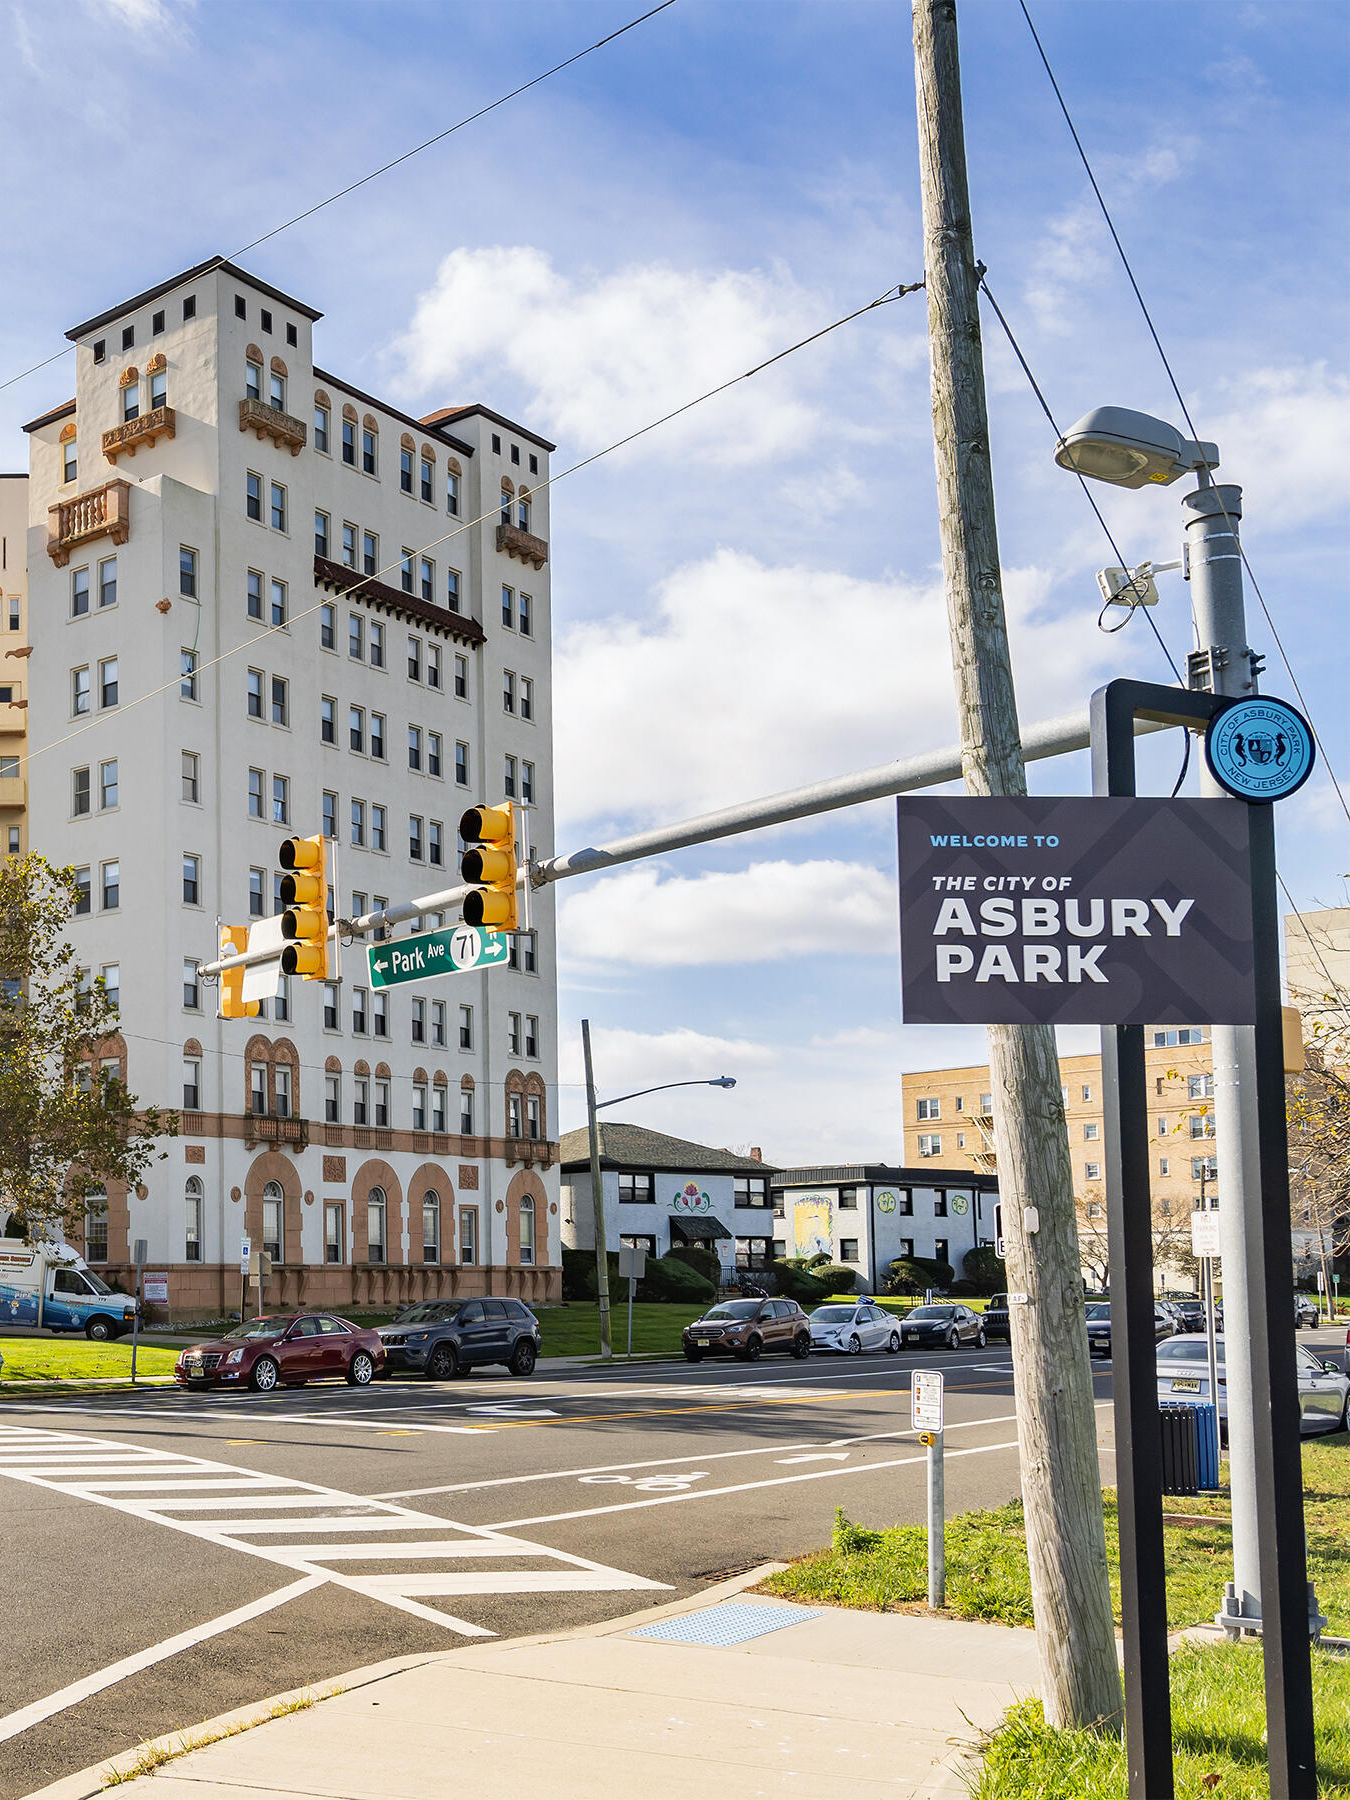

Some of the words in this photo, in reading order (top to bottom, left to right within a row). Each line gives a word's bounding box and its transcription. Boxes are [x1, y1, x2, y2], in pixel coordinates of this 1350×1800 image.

[1220, 731, 1230, 756] CITY
[1227, 716, 1240, 730] OF
[1243, 709, 1288, 725] ASBURY
[1286, 726, 1301, 755] PARK
[1228, 767, 1250, 786] NEW
[1253, 767, 1294, 789] JERSEY
[930, 835, 1028, 847] WELCOME
[1034, 835, 1060, 848] TO
[932, 876, 977, 891] THE
[983, 876, 1036, 891] CITY
[1041, 876, 1072, 891] OF
[932, 897, 1196, 938] ASBURY
[391, 946, 426, 974] Park
[427, 943, 445, 959] Ave
[456, 933, 475, 960] 71
[935, 944, 1110, 983] PARK
